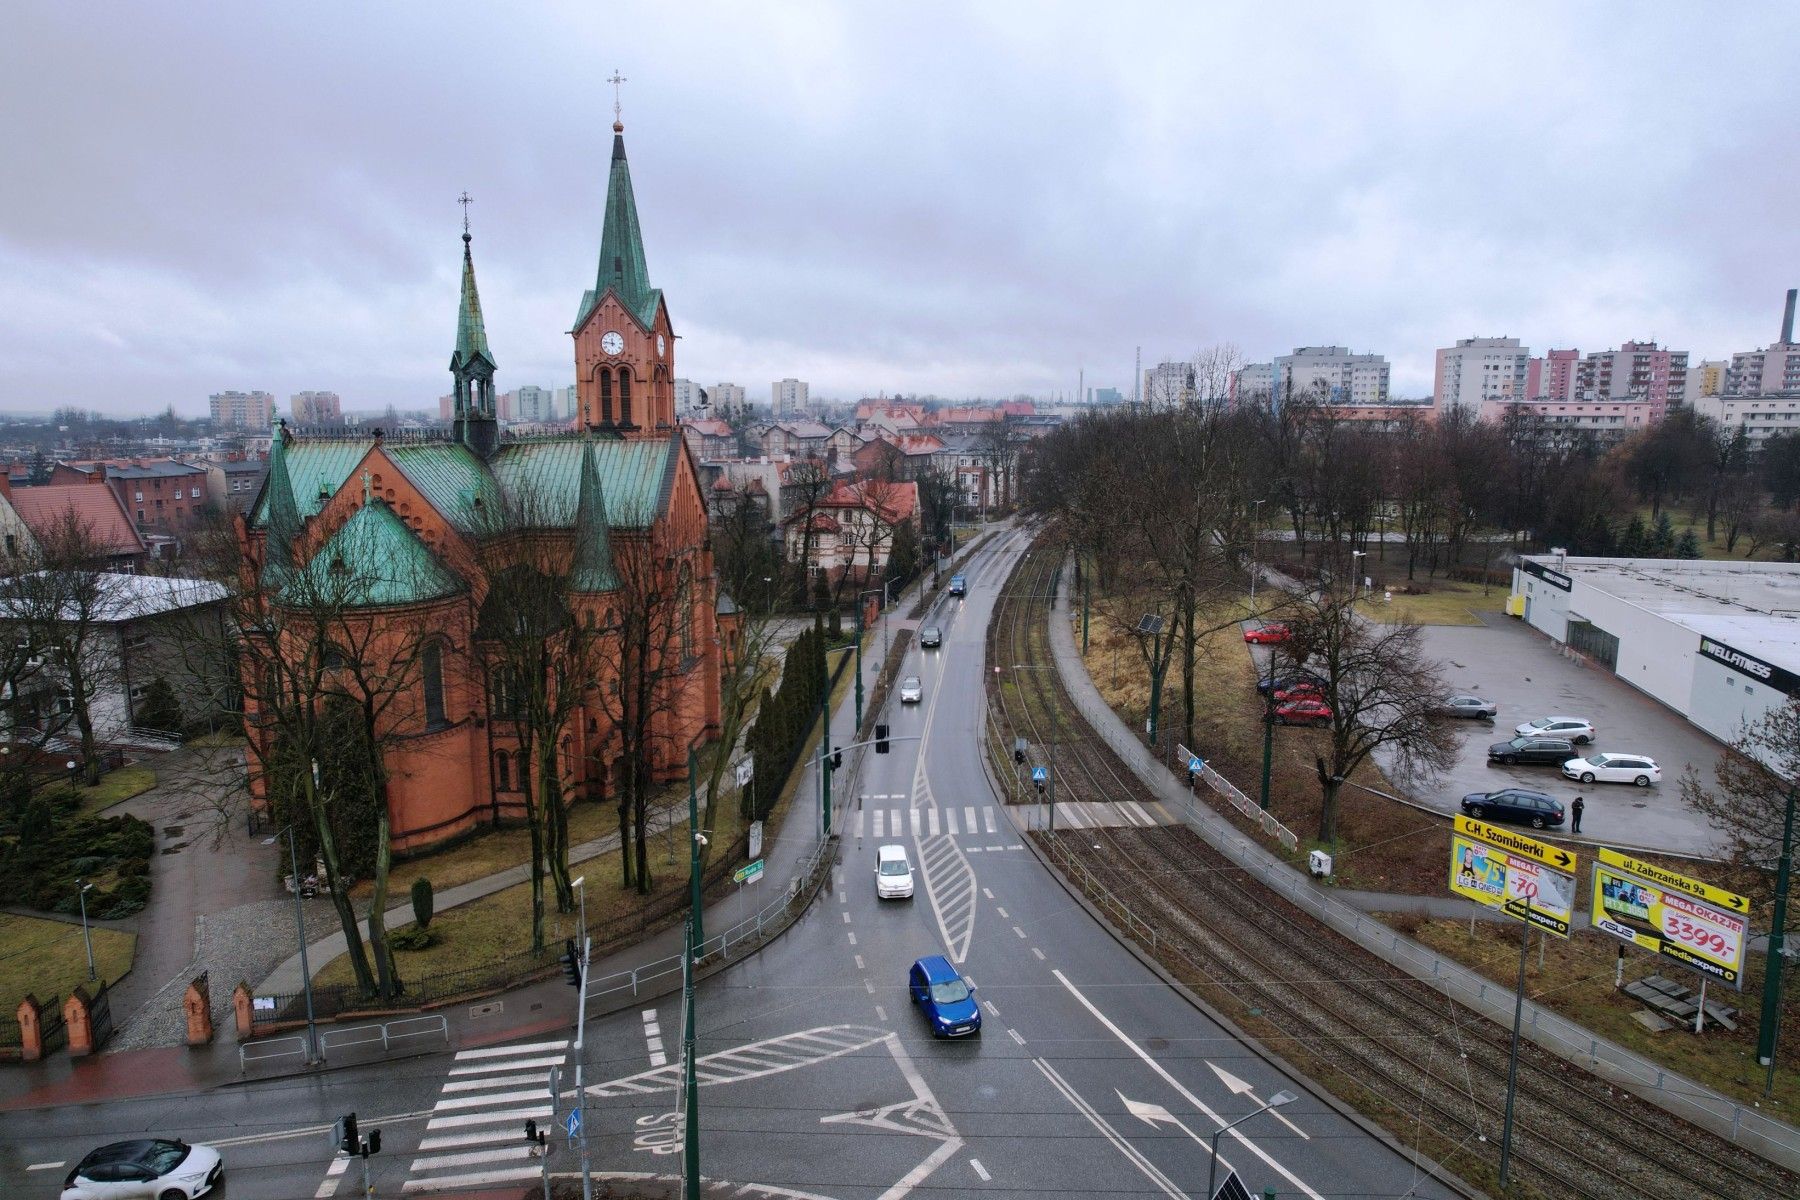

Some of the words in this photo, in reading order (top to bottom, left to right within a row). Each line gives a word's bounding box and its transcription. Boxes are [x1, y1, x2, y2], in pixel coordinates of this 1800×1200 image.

[1708, 642, 1772, 678] WELLFITNESS
[1465, 821, 1484, 837] C.H.
[1486, 828, 1544, 858] Szombierki
[1509, 858, 1532, 871] MEGA
[1623, 860, 1635, 870] ul.
[1637, 863, 1691, 890] Zabrzańska
[1693, 884, 1705, 896] 9a
[1458, 876, 1469, 886] LG
[1508, 903, 1557, 928] medexpert
[1606, 898, 1624, 911] RTX
[1665, 896, 1692, 912] MEGA
[1695, 906, 1742, 933] OKAZJE!
[1600, 920, 1634, 938] ASUS
[1663, 946, 1724, 976] mediaexpert
